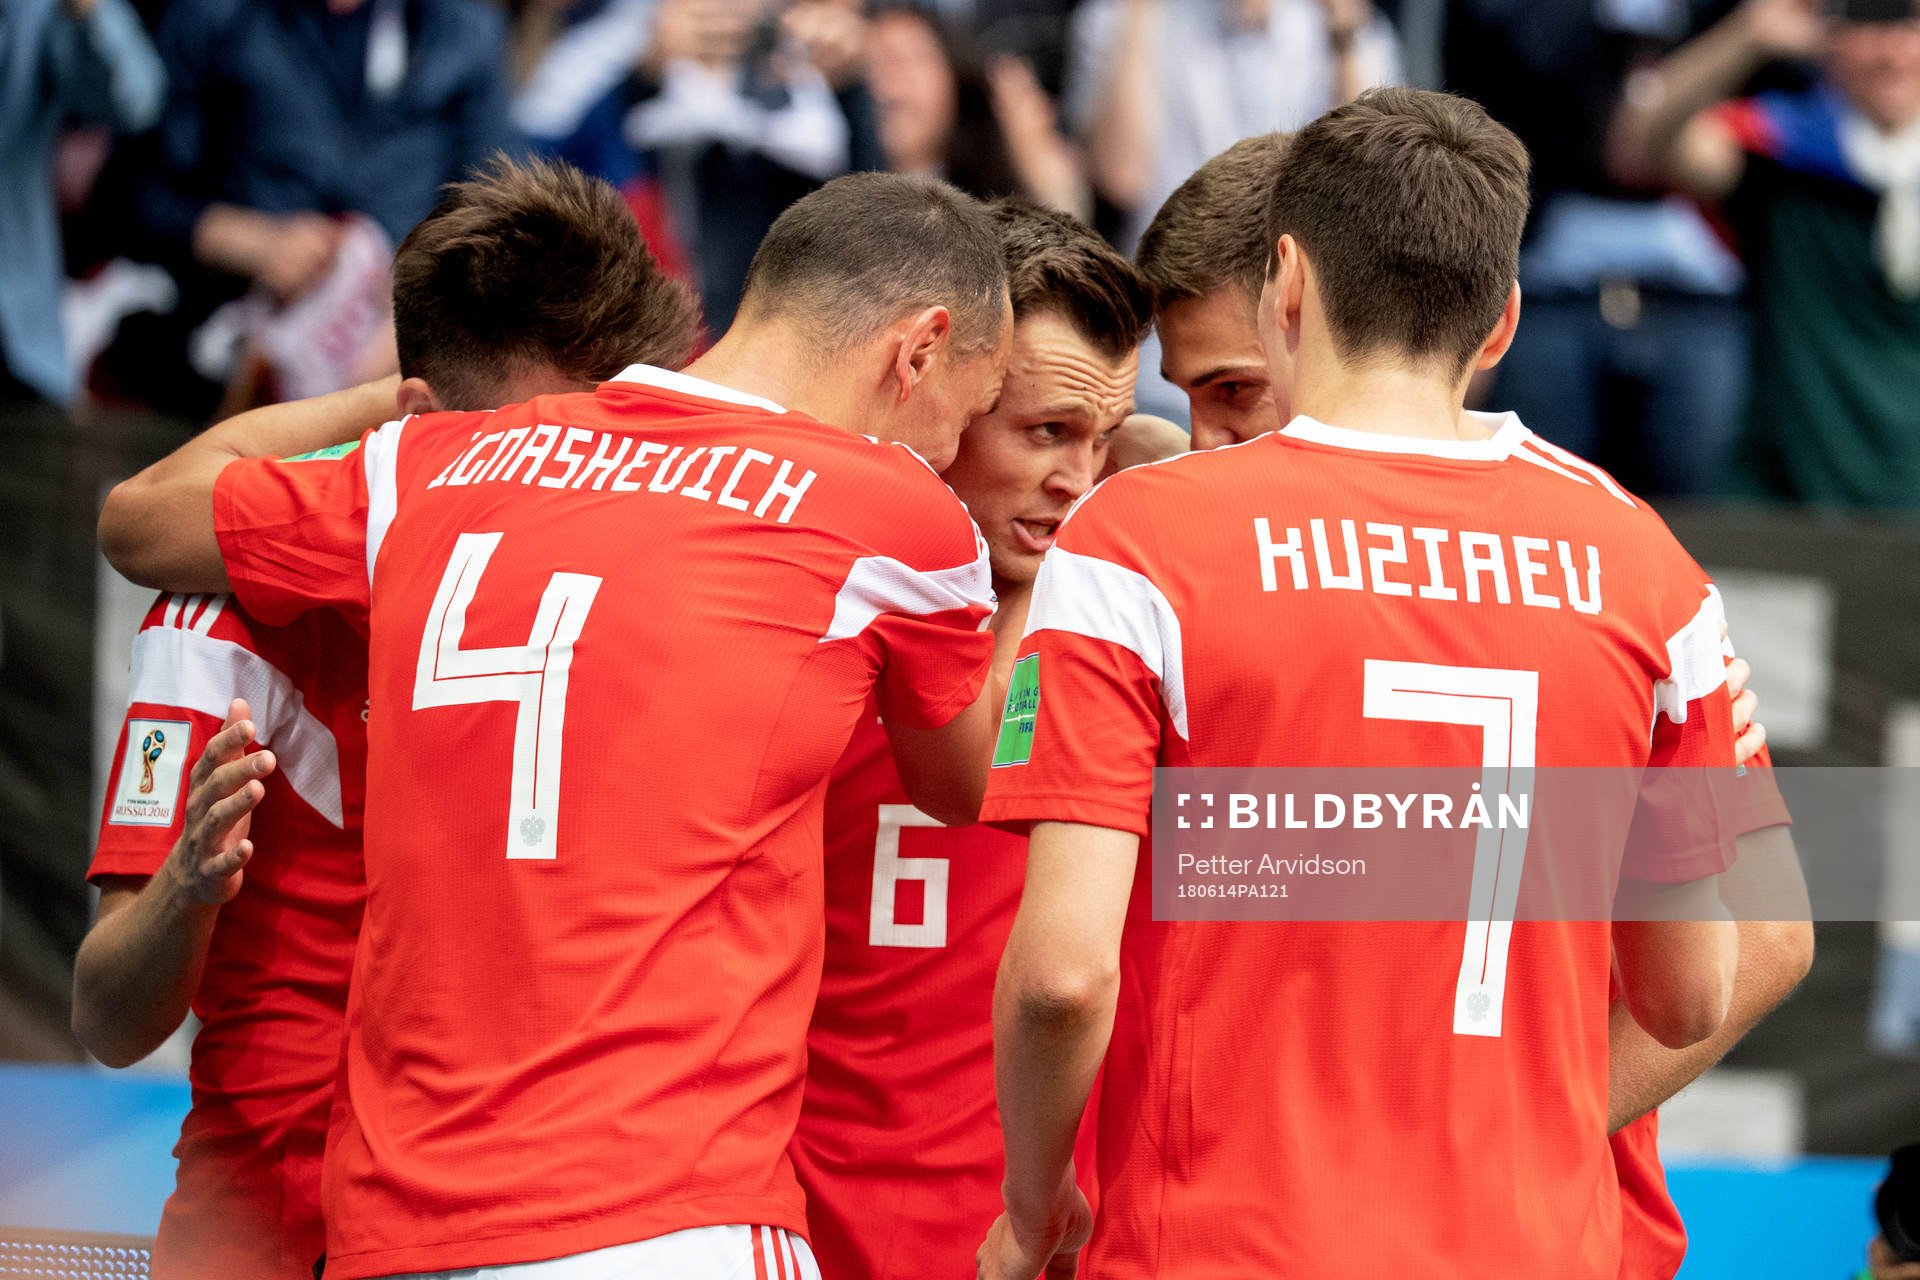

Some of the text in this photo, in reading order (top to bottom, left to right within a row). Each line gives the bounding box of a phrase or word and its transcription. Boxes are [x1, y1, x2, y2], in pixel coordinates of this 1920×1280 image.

[427, 424, 817, 523] IGNASHEVICH
[1254, 518, 1602, 615] KUZIAEV
[412, 532, 603, 859] 4
[116, 806, 169, 817] RUSSIA 2018
[1363, 659, 1539, 1038] 7
[869, 804, 949, 948] 6
